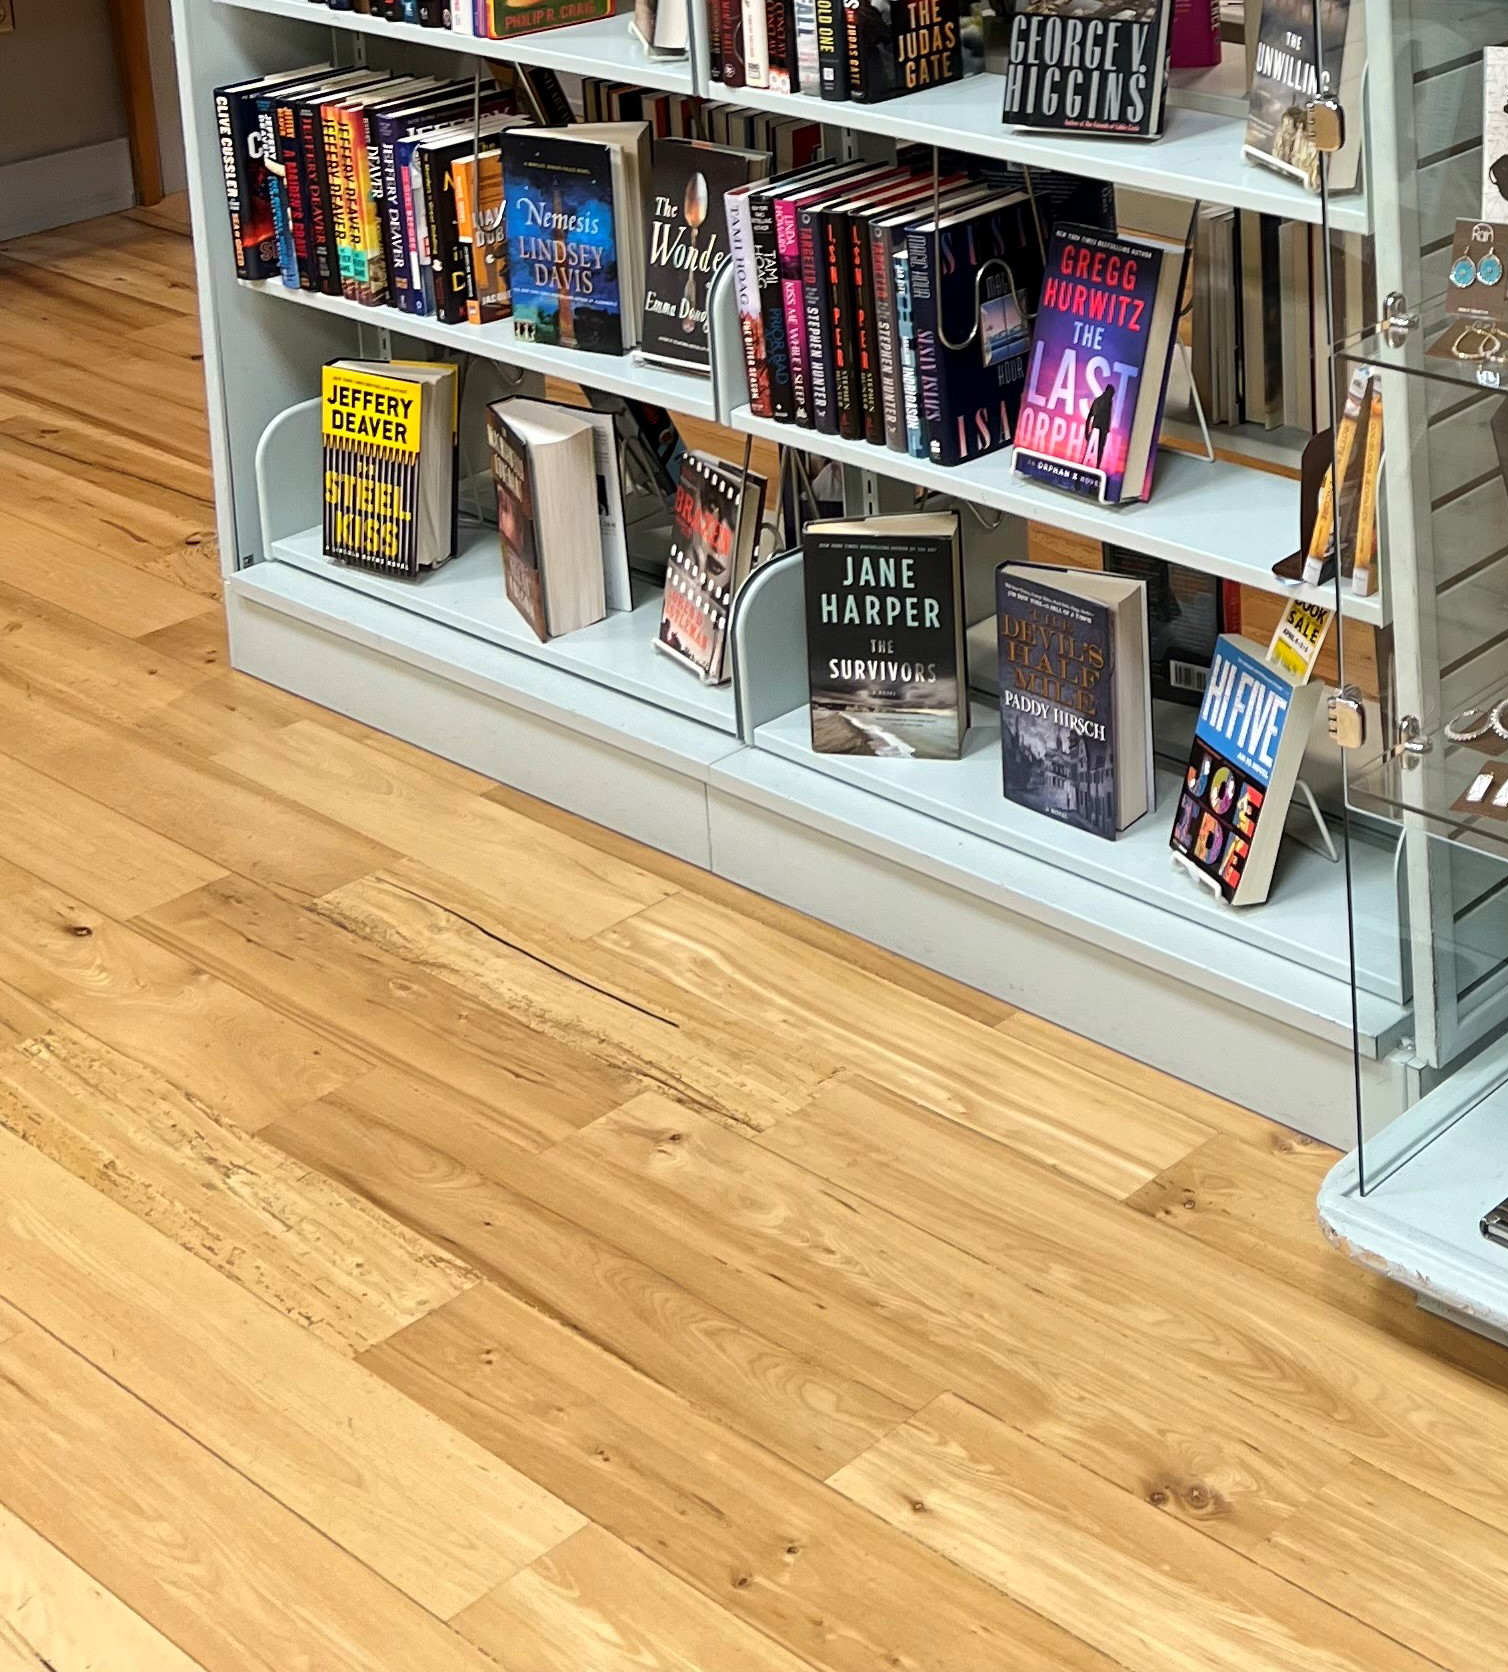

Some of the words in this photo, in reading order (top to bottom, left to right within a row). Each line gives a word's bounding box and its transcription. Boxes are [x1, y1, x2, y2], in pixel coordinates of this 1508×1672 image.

[819, 28, 834, 53] ONE
[898, 21, 955, 62] JUDAS
[1010, 14, 1122, 71] GEORGE
[905, 52, 952, 89] GATE
[1004, 63, 1145, 123] HIGGINS
[216, 96, 234, 135] CLIVE
[221, 138, 237, 197] CUSSLER
[302, 118, 318, 181] JEFFERY
[309, 185, 325, 243] DEAVER
[516, 197, 600, 234] Nemesis
[656, 196, 678, 218] The
[518, 235, 603, 269] LINDSEY
[1061, 245, 1137, 291] GREGG
[534, 264, 593, 294] DAVIS
[1043, 277, 1145, 331] HURWITZ
[879, 321, 895, 373] STEPHEN
[1072, 320, 1104, 350] THE
[327, 385, 414, 420] JEFFERY
[883, 377, 896, 423] HUNTER
[1027, 340, 1139, 430] LAST
[331, 409, 408, 445] DEAVER
[325, 471, 412, 522] STEEL
[843, 557, 915, 589] JANE
[820, 593, 941, 629] HARPER
[869, 638, 895, 655] THE
[829, 658, 937, 683] SURVIVORS
[1004, 690, 1050, 722] PADDY
[1052, 704, 1106, 743] HIRSCH
[1202, 654, 1235, 734] HI
[1226, 675, 1288, 769] FIVE
